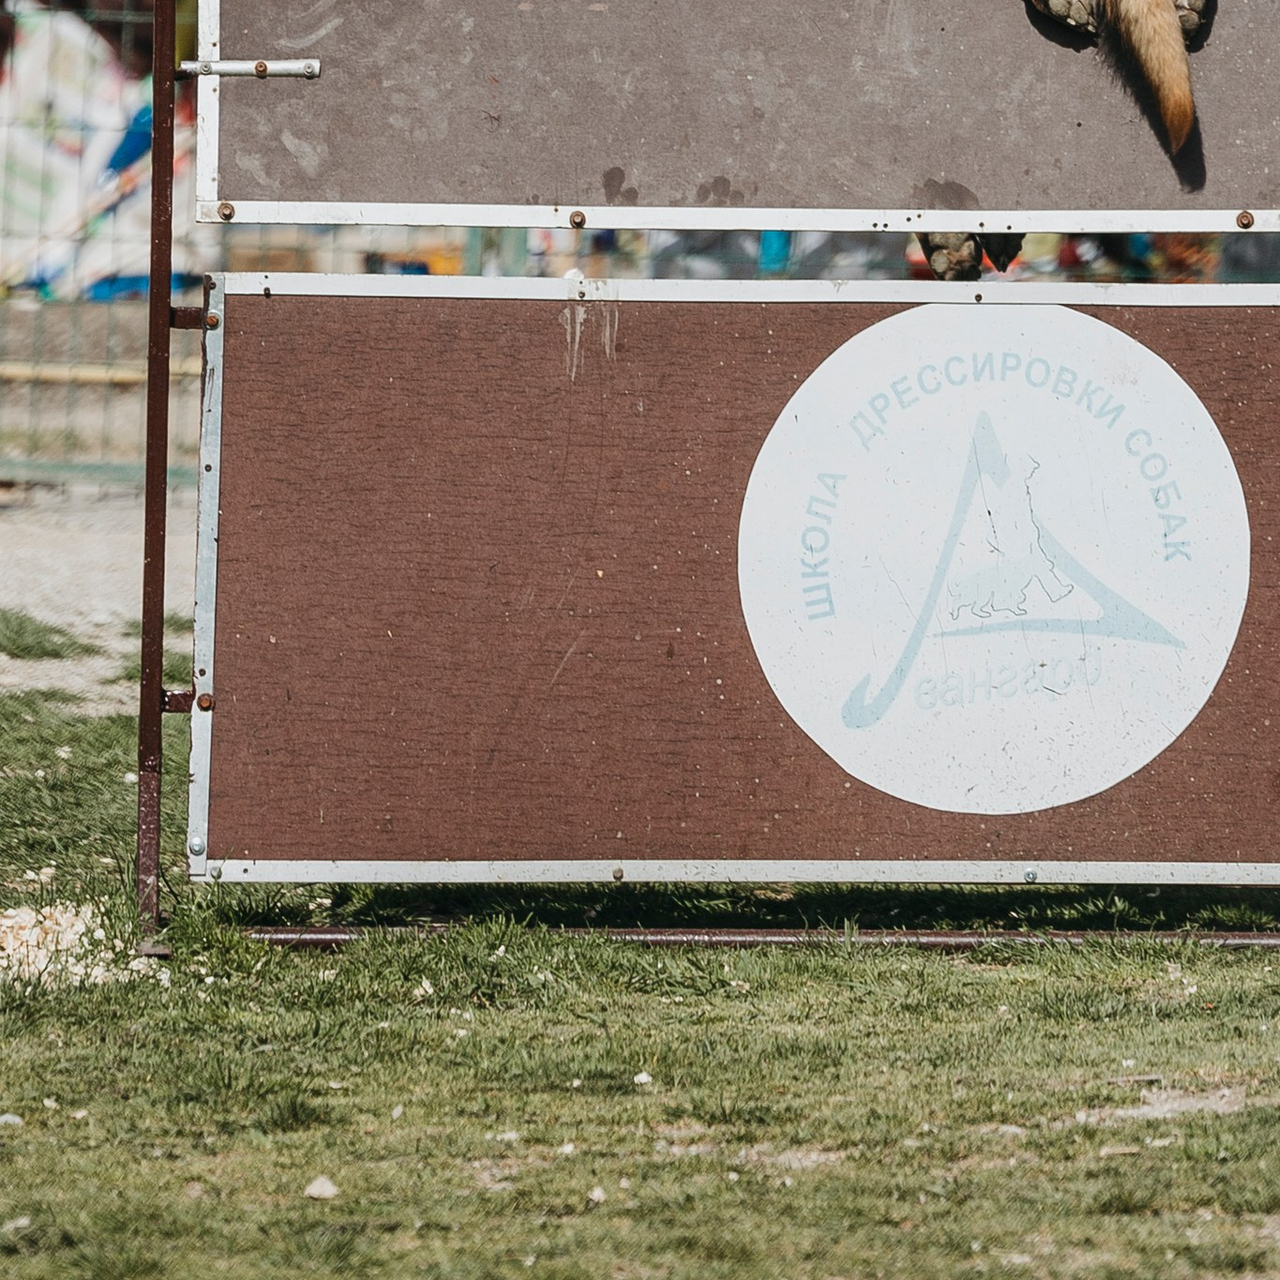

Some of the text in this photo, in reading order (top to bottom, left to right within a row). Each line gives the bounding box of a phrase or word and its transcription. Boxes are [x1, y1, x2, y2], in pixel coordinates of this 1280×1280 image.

[799, 351, 1192, 621] ШКОЛА ДРЕССИРОВКИ СОБАК
